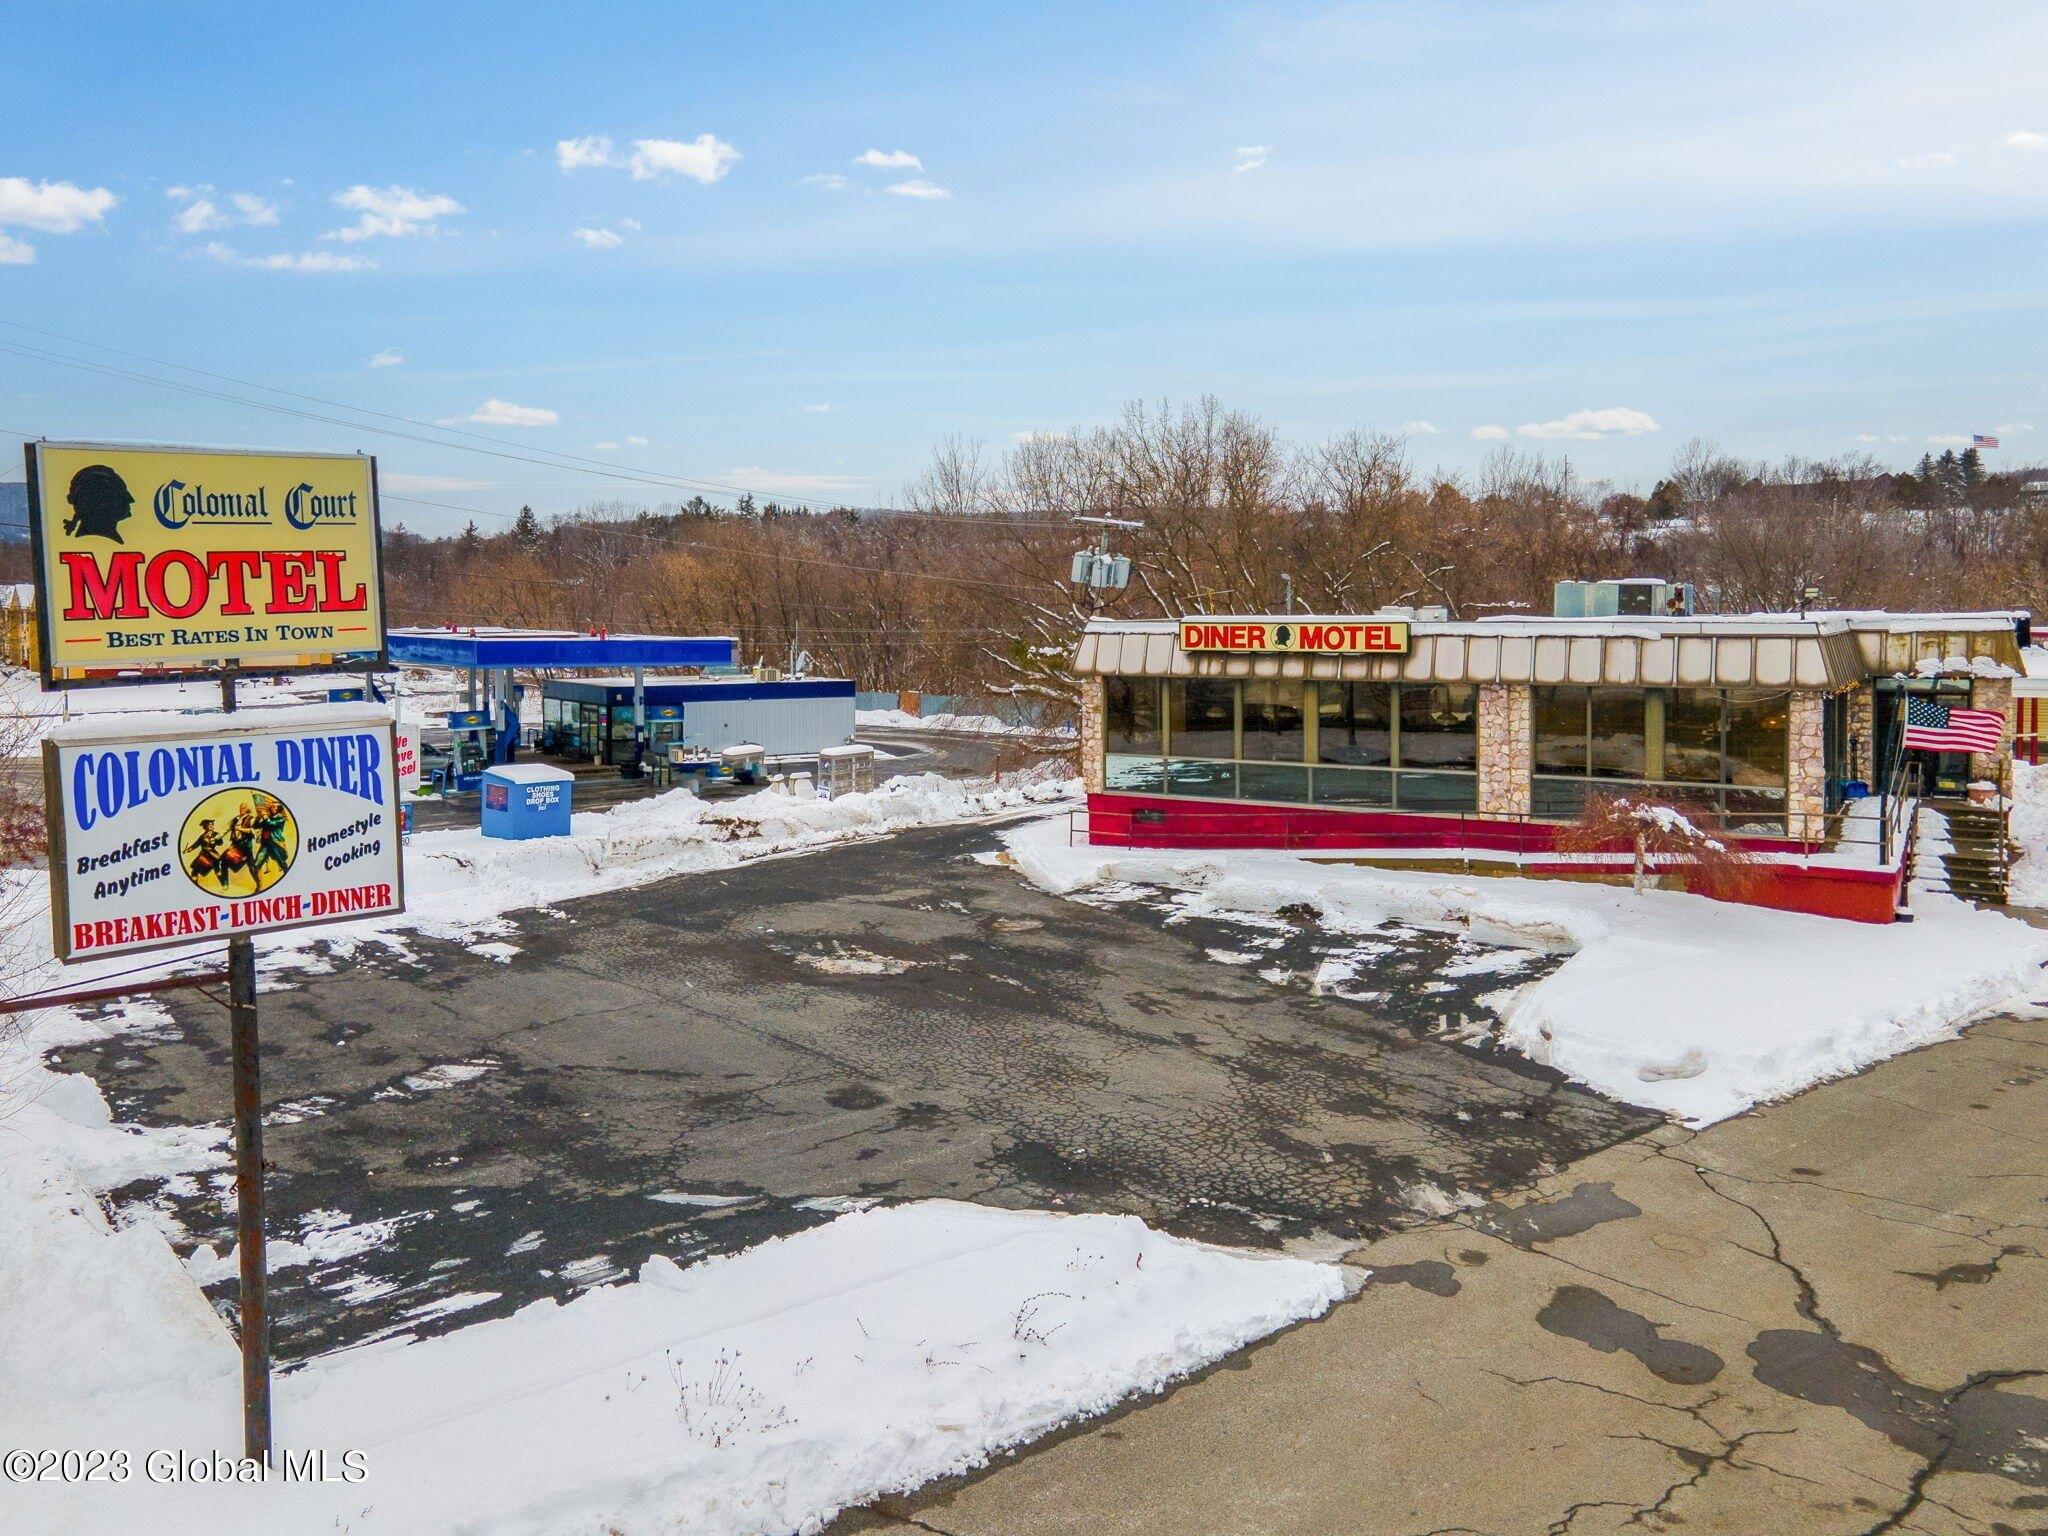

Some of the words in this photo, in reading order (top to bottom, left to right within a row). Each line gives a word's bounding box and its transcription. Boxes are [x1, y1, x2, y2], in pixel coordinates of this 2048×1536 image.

[154, 479, 269, 529] Colonial
[284, 482, 358, 530] Court
[59, 550, 367, 620] MOTEL
[107, 631, 164, 648] BEST
[171, 628, 239, 645] RATES
[276, 624, 333, 640] TOWN
[1184, 625, 1266, 649] DINER
[1299, 625, 1402, 650] MOTEL
[73, 742, 260, 831] COLONIAL
[276, 733, 384, 806] DINER
[526, 784, 560, 793] CLOTHING
[532, 791, 554, 799] SHOES
[526, 797, 544, 805] DROP
[545, 796, 560, 804] BOX
[307, 812, 382, 853] Homestyle
[77, 831, 169, 875] Breakfast
[325, 839, 381, 872] Cooking
[94, 861, 171, 900] Anytime
